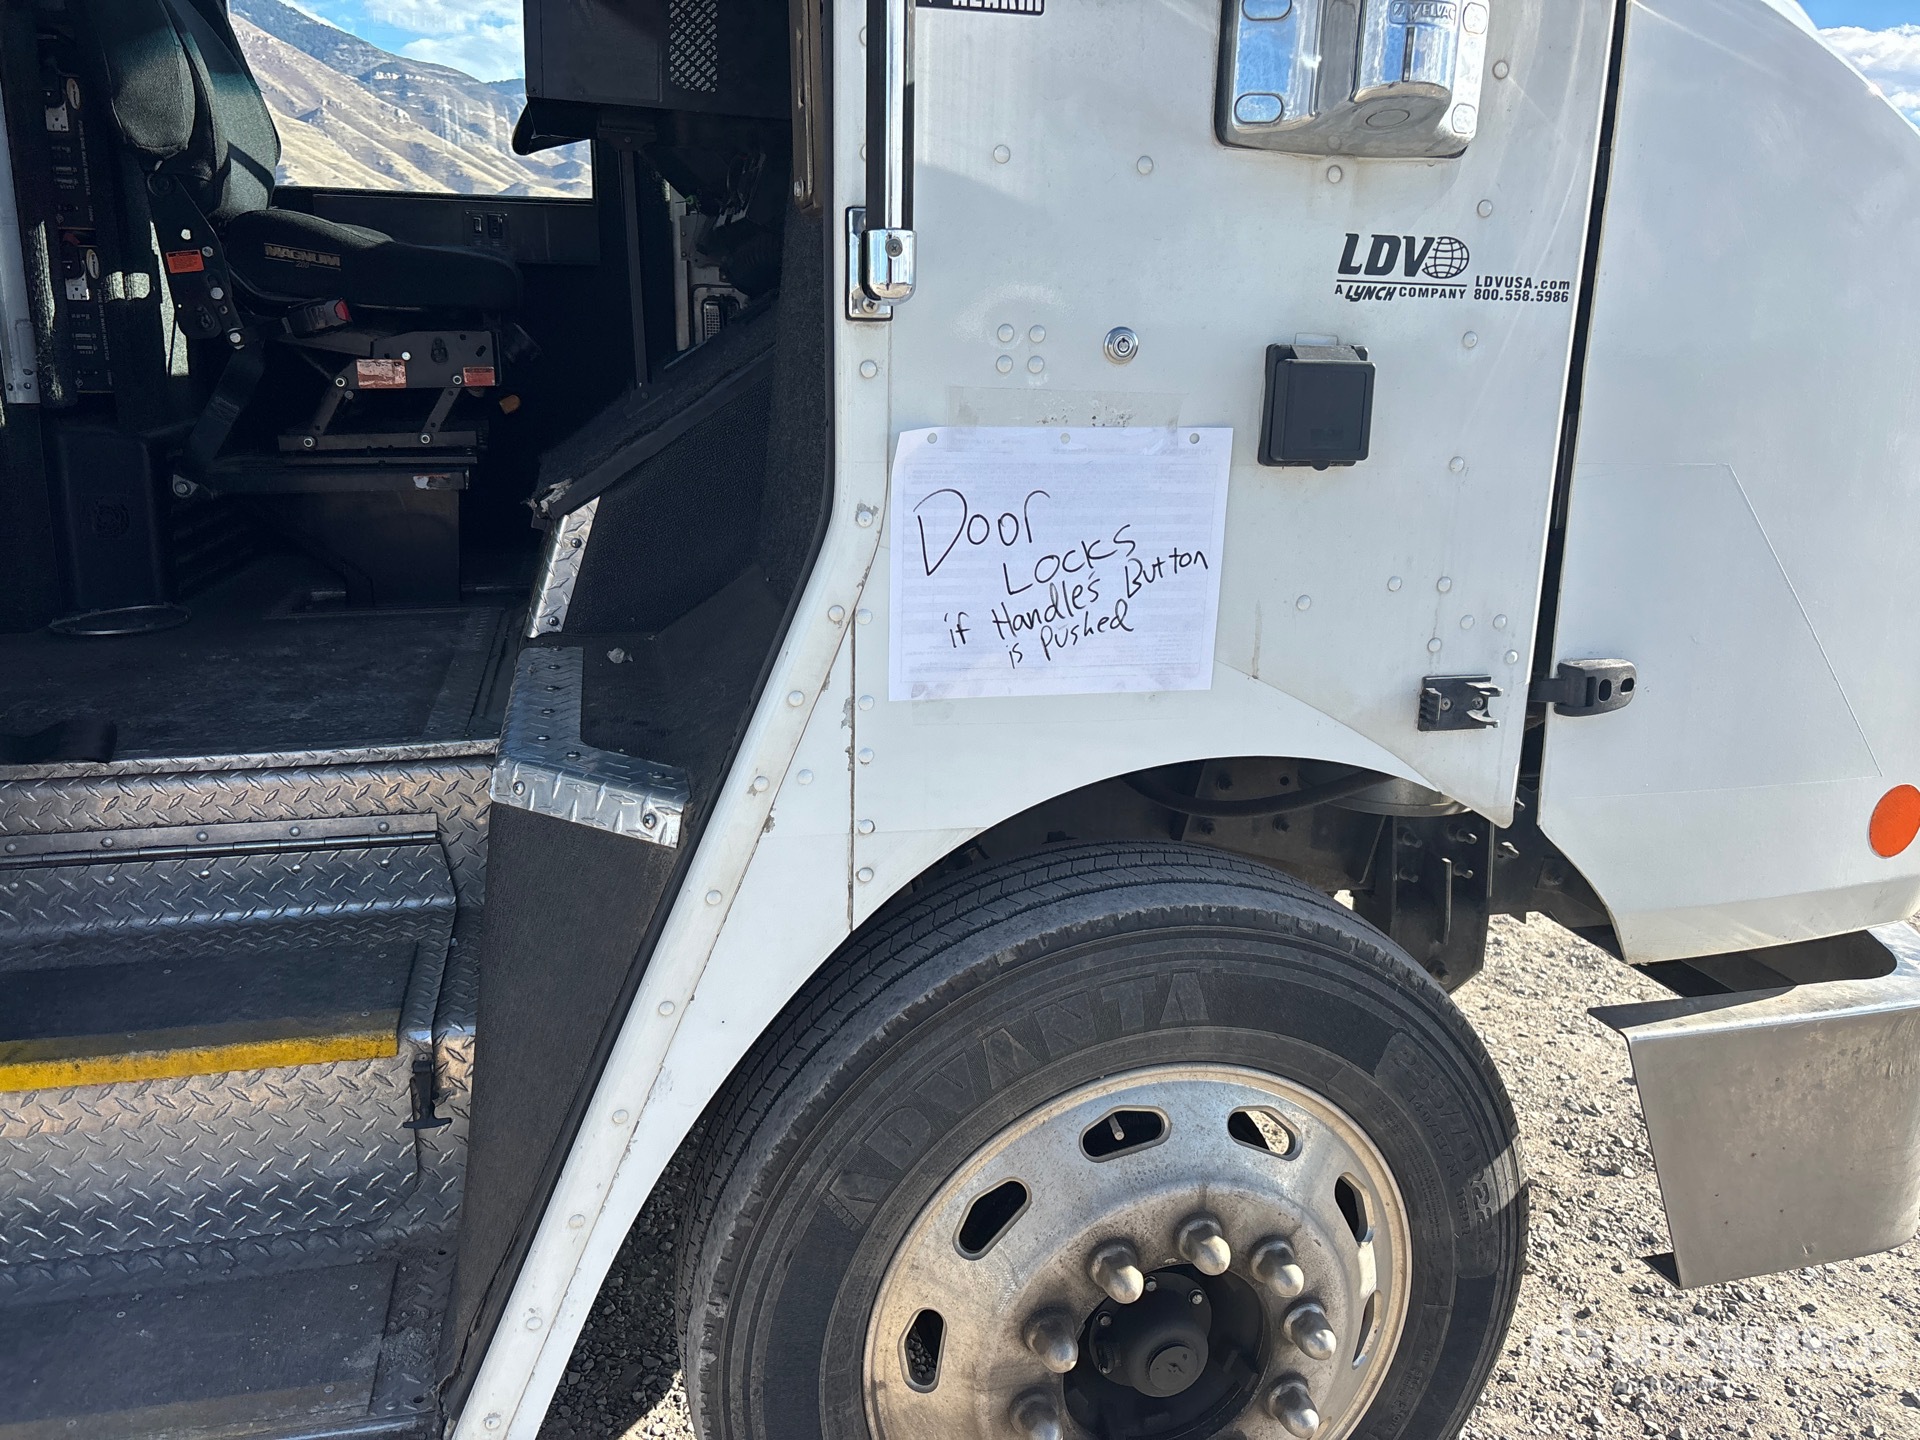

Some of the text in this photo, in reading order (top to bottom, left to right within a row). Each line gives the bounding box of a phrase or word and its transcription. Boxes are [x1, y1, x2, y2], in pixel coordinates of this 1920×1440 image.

[1409, 3, 1454, 19] VELVAC
[264, 246, 341, 266] MAGNUM
[1337, 232, 1436, 278] LDV
[1475, 275, 1571, 290] LDVUSA.com
[1334, 284, 1467, 302] A LYNCH COMPANY
[1473, 288, 1570, 303] 800.558.5986
[913, 488, 1051, 577] Door
[943, 547, 1209, 648] if Handle's Button
[1005, 643, 1024, 669] is
